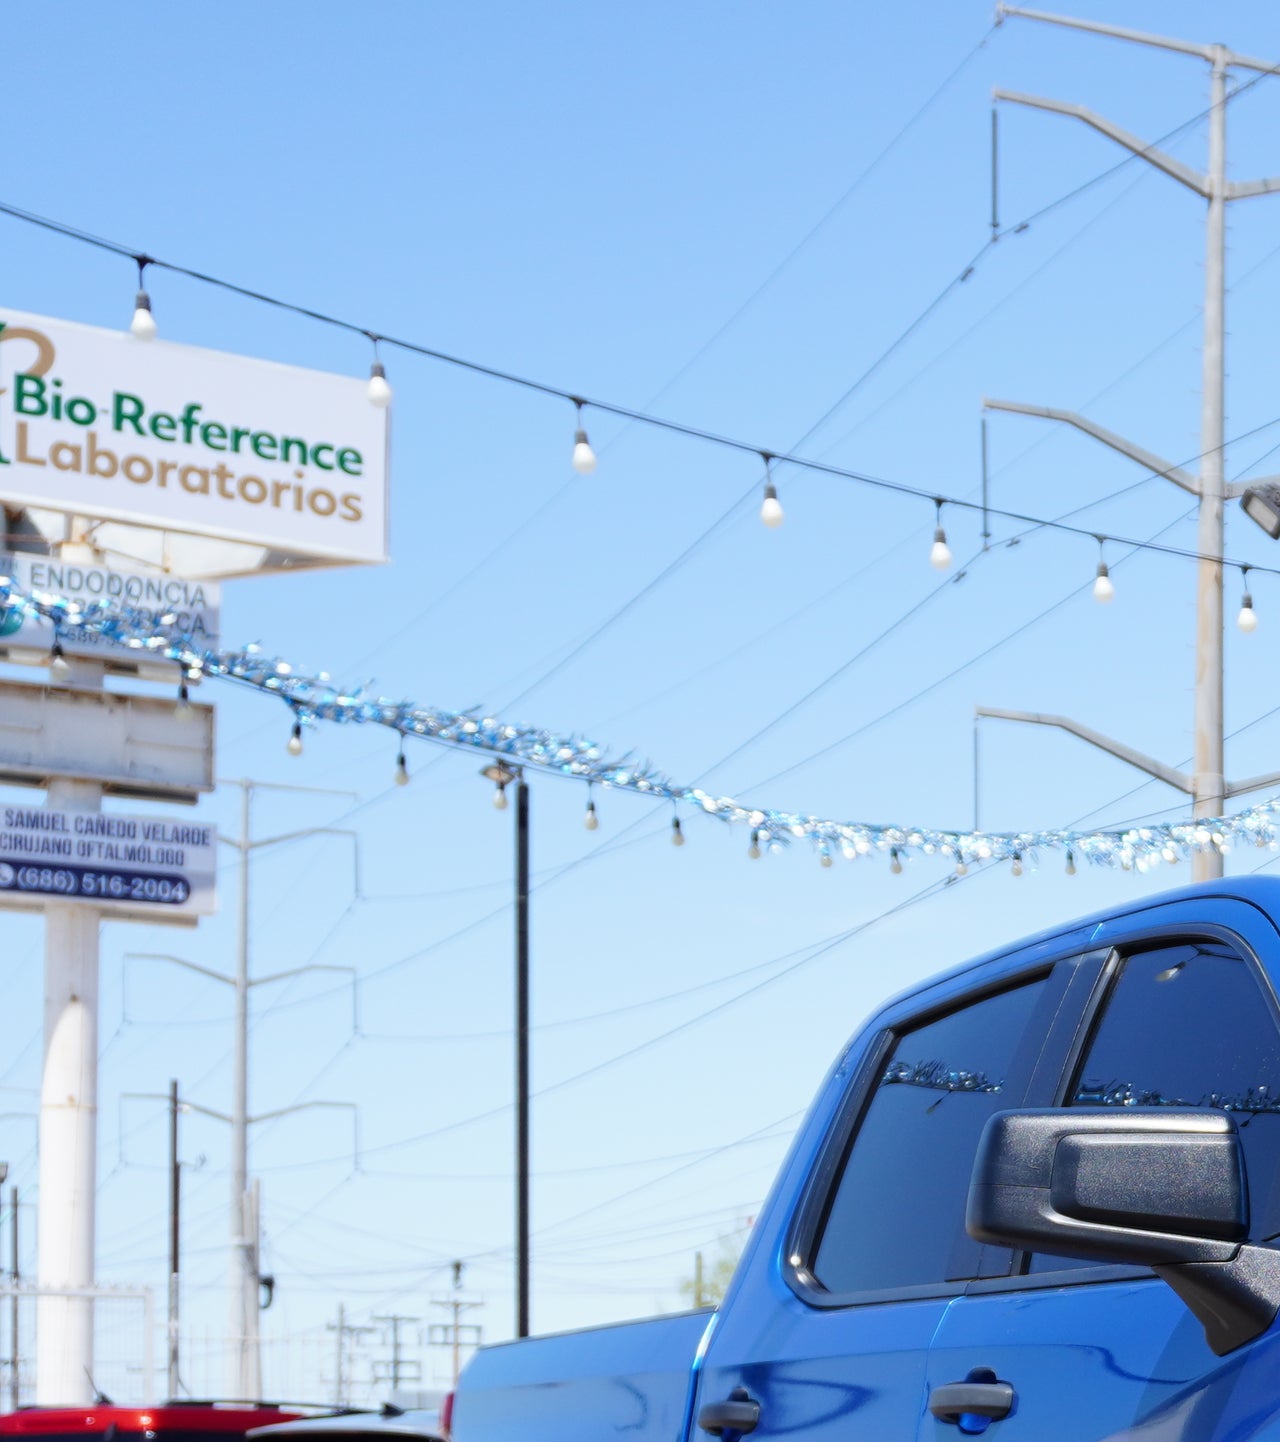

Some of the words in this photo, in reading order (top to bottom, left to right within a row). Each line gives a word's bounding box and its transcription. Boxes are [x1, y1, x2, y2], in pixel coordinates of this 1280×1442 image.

[16, 421, 363, 523] Laboratorios
[30, 562, 207, 608] ENDODONCIA
[0, 831, 72, 856] CIRUJANO
[5, 808, 70, 832] SAMUEL
[143, 821, 210, 846] VELARDE
[17, 866, 76, 893] (686)
[82, 872, 186, 901] 516-2004
